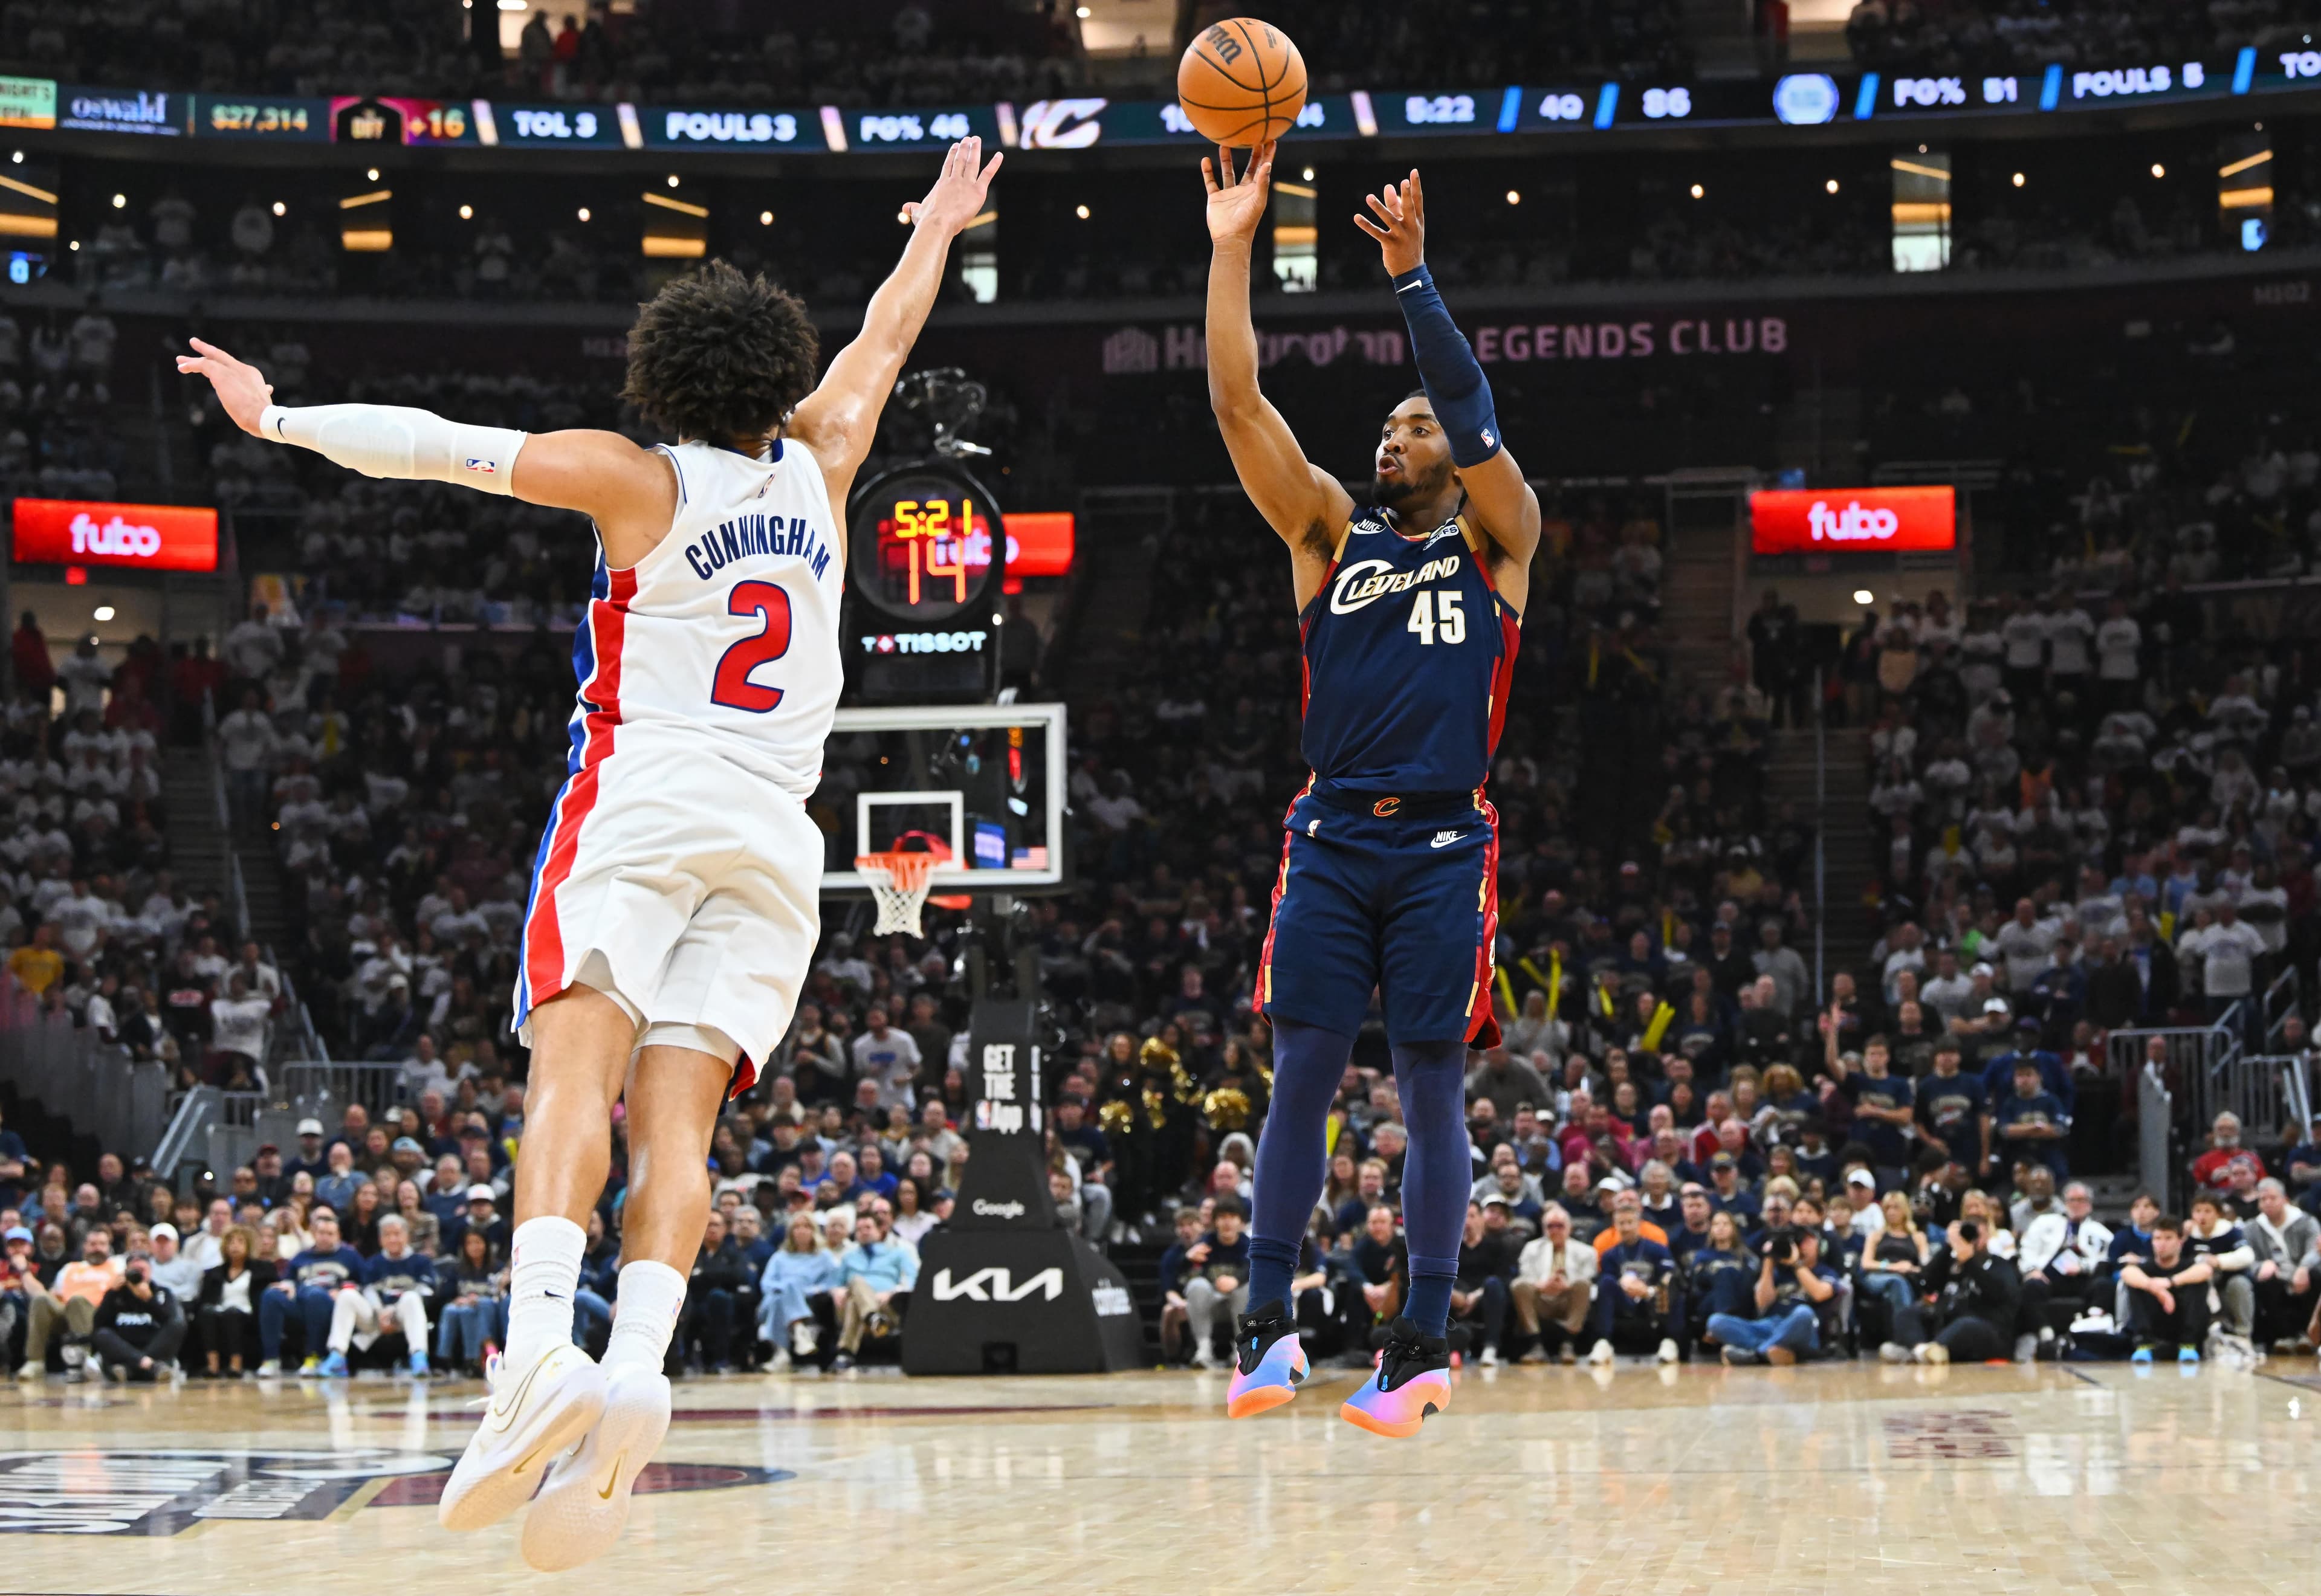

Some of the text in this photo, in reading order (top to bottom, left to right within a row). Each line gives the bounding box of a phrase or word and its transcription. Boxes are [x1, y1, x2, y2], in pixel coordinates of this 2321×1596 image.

[1983, 77, 2018, 103] 51
[2073, 62, 2204, 99] FOULS 5
[71, 91, 168, 123] oswald
[1405, 95, 1475, 124] 5:22
[1643, 88, 1691, 118] 86
[410, 109, 465, 138] +16
[513, 111, 598, 138] TOL 3
[667, 112, 798, 141] FOULS 3
[1477, 322, 1655, 363] EGENDS
[1669, 317, 1788, 355] CLUB
[895, 499, 972, 538] 5:21
[1359, 519, 1383, 532] NIKE
[1807, 501, 1899, 541] fubo
[69, 512, 161, 557] fubo
[685, 514, 831, 583] CUNNINGHAM
[909, 538, 966, 604] 14
[1330, 555, 1460, 615] CLEVELAND
[1407, 590, 1466, 645] 45
[710, 580, 792, 714] 2
[895, 632, 987, 654] TISSOT
[1436, 830, 1458, 842] NIKE
[983, 1044, 1015, 1071] GET
[983, 1072, 1016, 1100] THE
[973, 1198, 1025, 1220] Google
